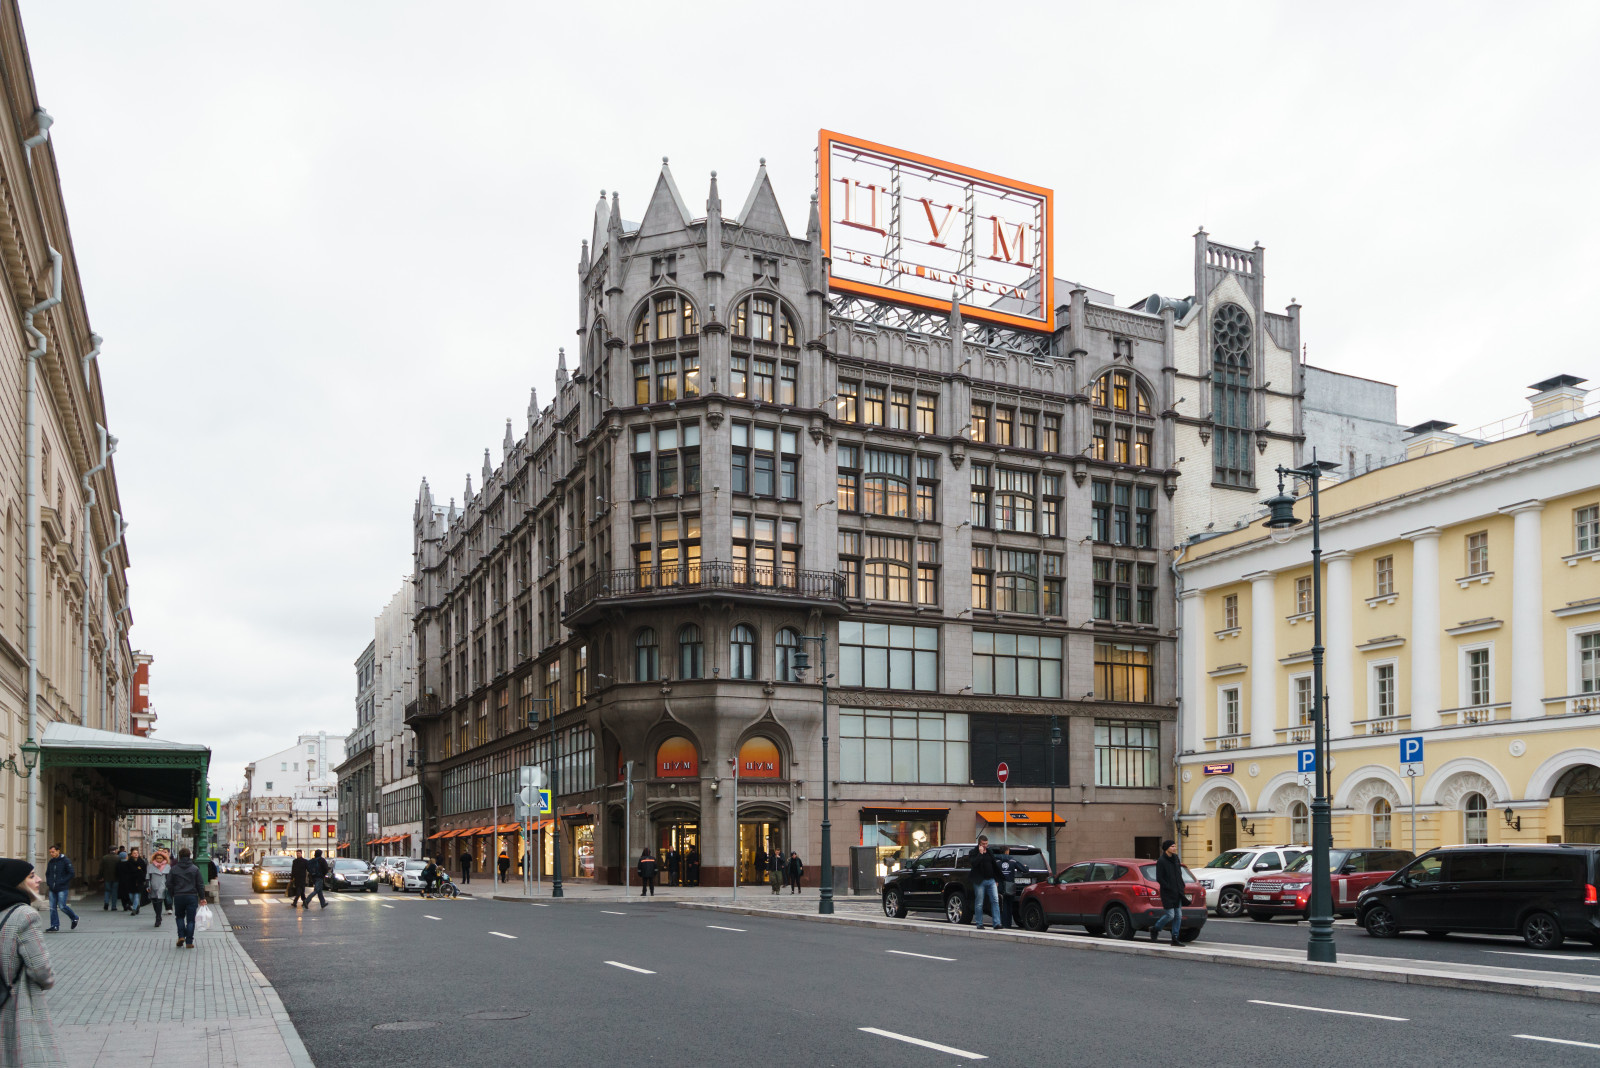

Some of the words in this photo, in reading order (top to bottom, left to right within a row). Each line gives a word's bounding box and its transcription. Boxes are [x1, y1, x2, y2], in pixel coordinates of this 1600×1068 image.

[846, 250, 910, 275] TSUM
[929, 269, 1028, 300] MOSCOW
[1302, 751, 1315, 771] P
[1405, 739, 1420, 761] P
